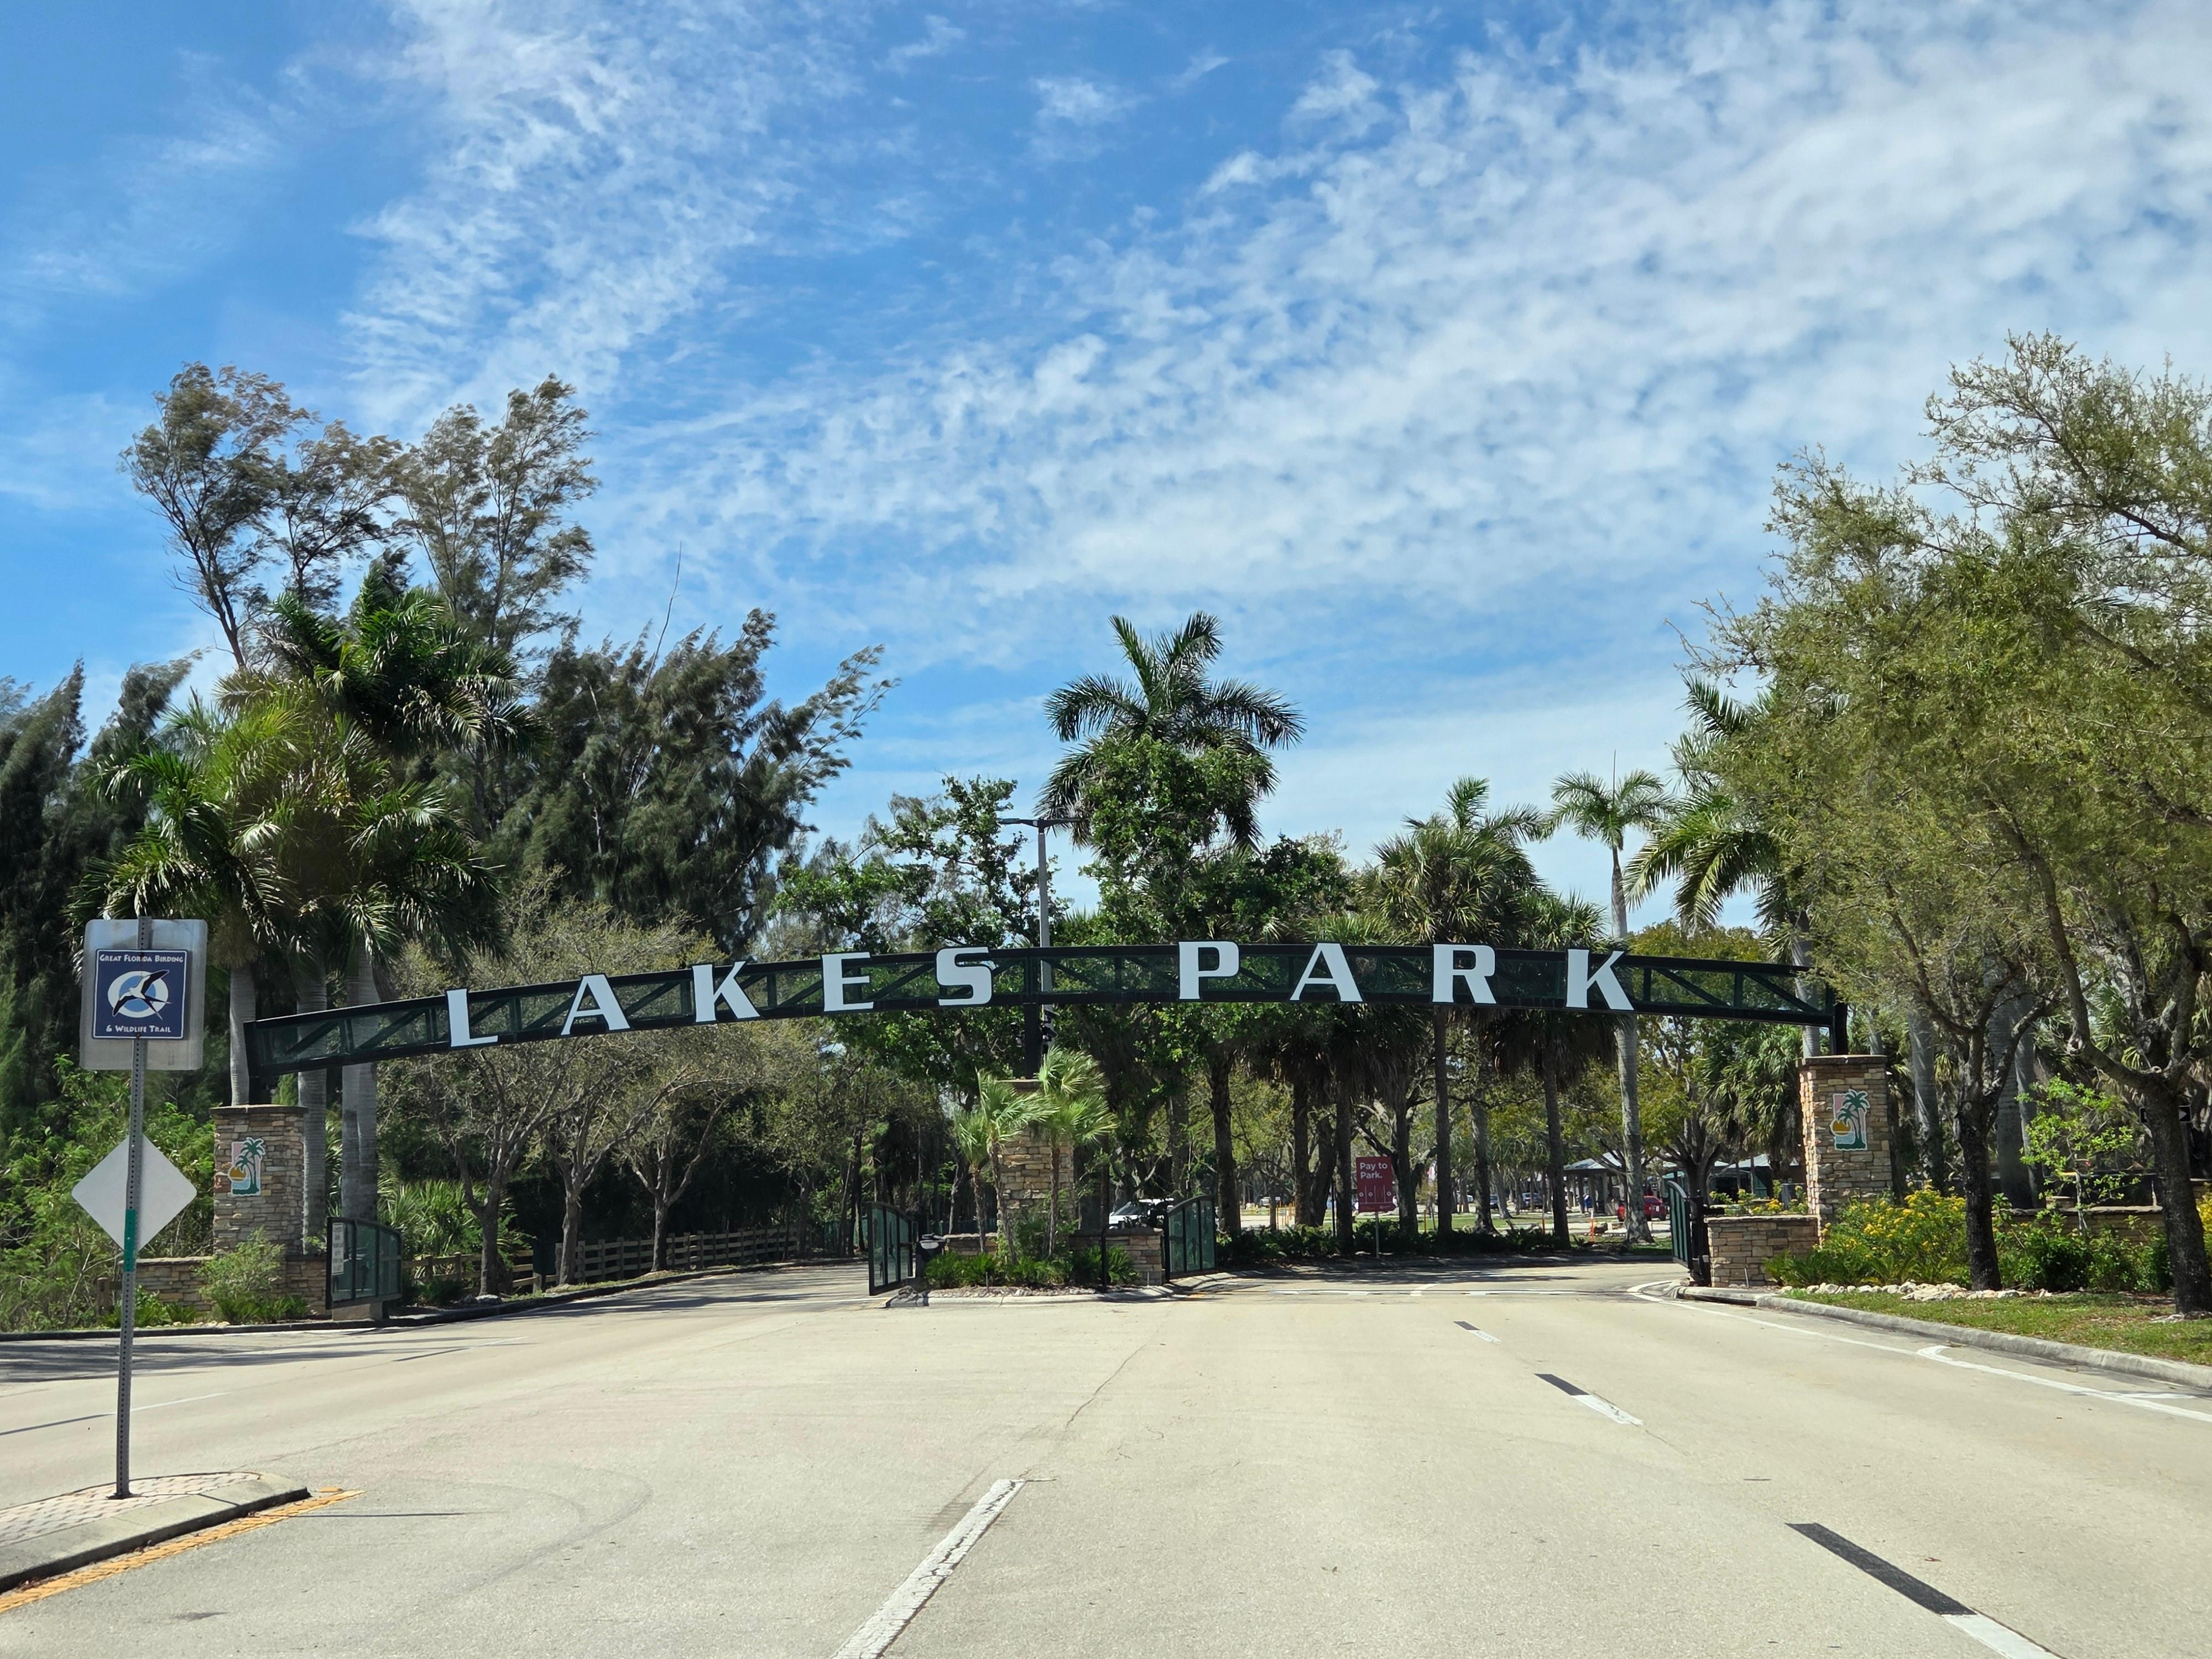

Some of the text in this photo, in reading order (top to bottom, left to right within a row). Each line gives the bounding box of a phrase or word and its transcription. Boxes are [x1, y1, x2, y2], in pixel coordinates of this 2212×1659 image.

[447, 941, 1634, 1047] LAKES PARK
[1360, 1162, 1376, 1171] Pay
